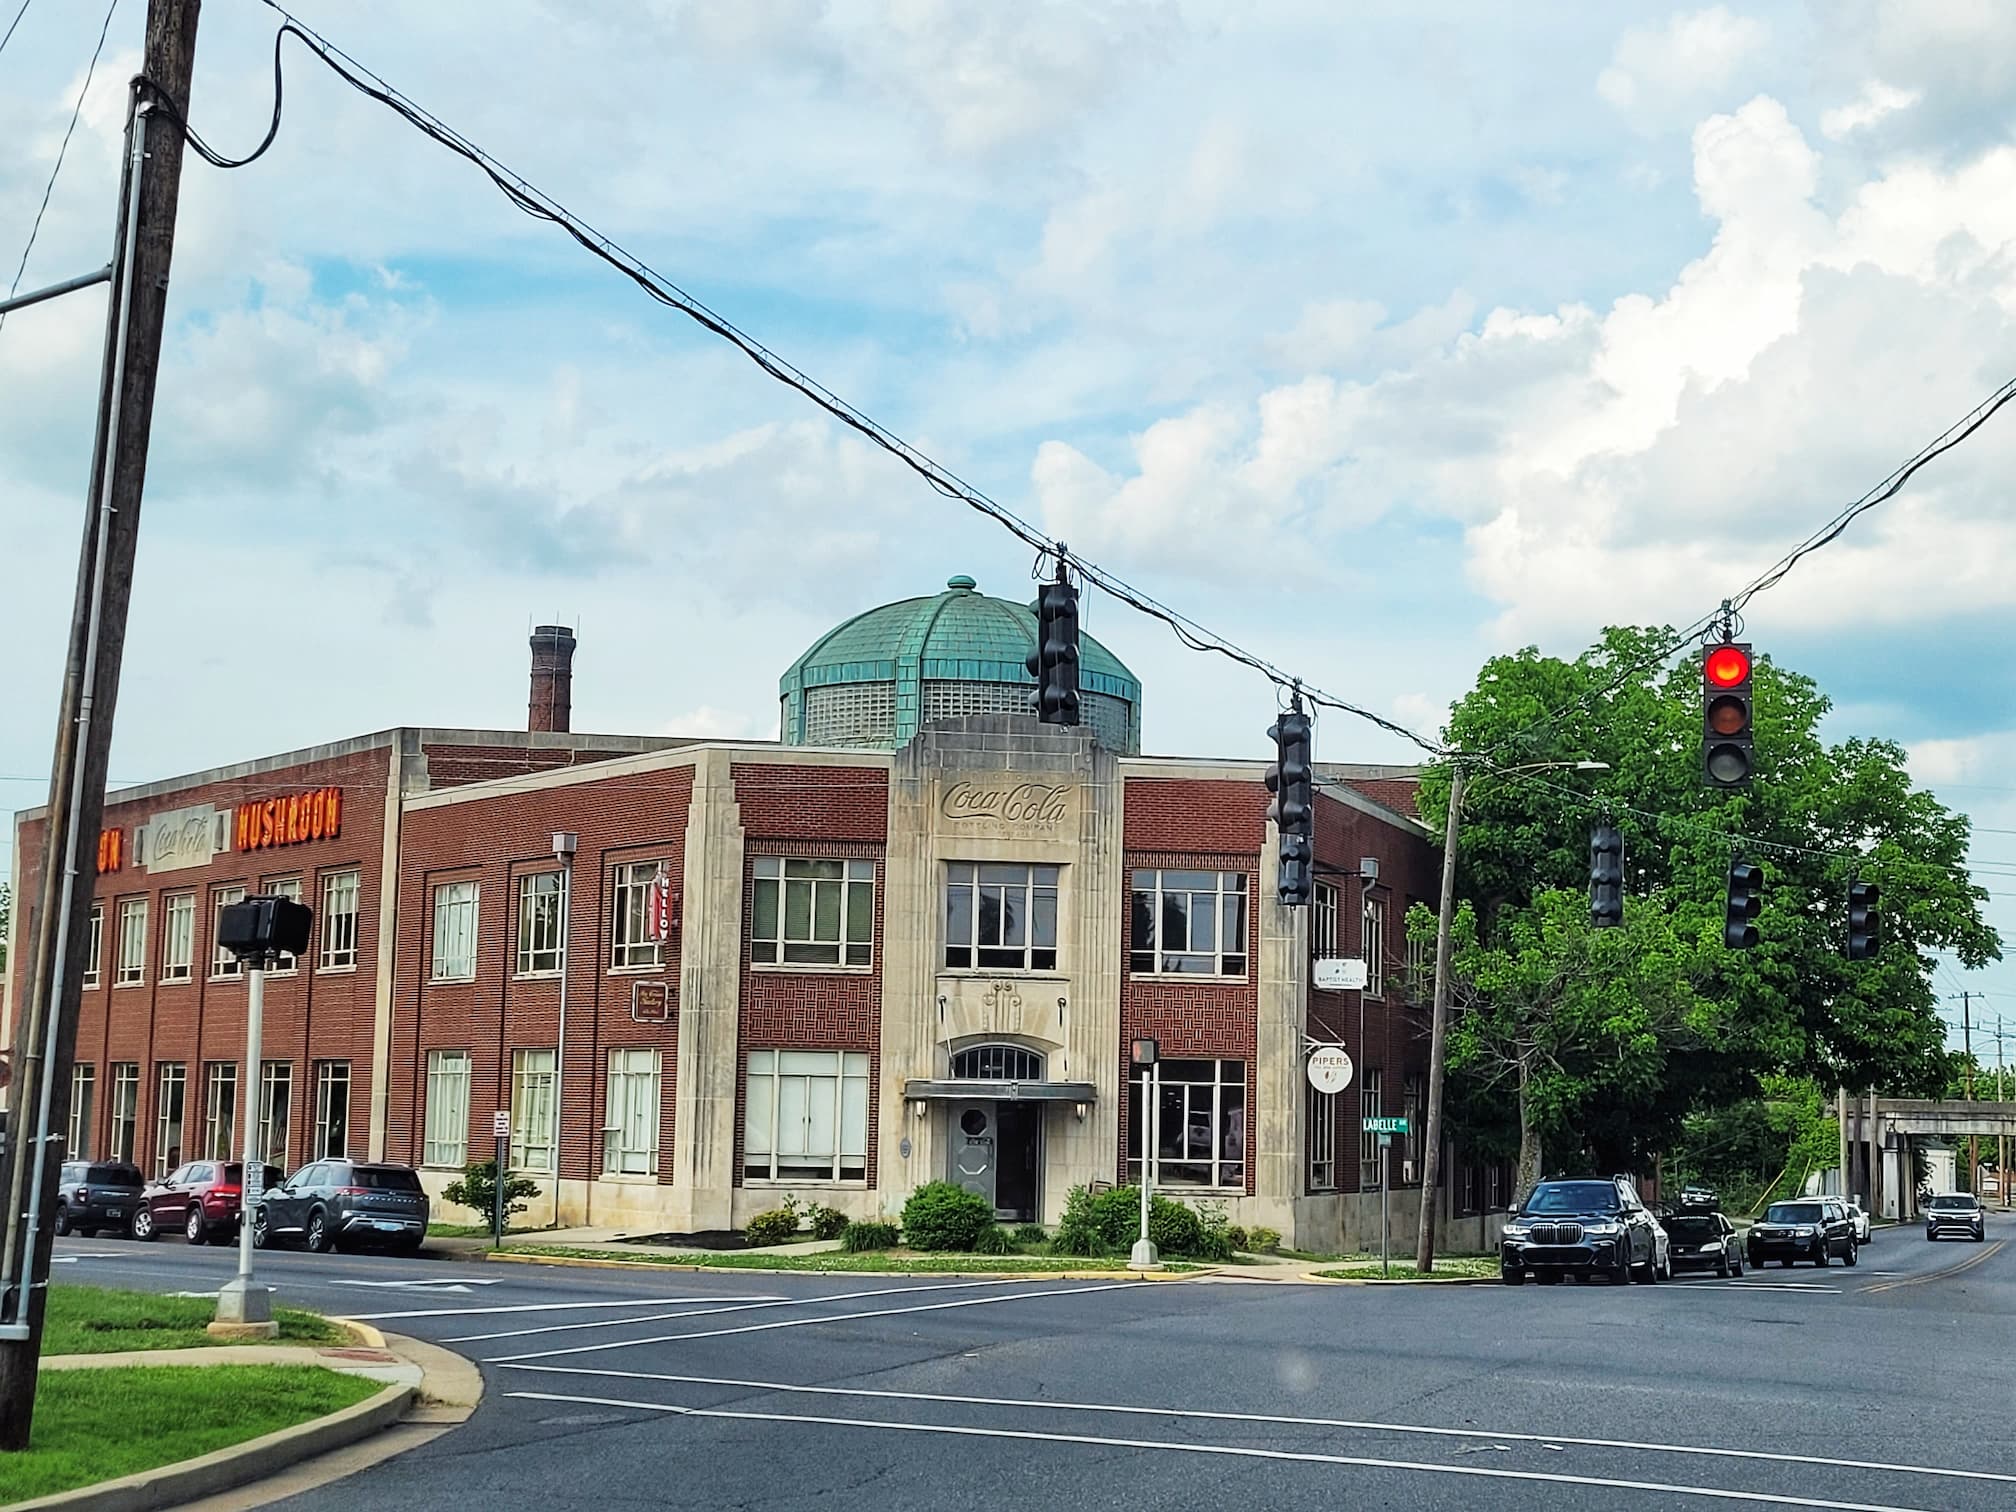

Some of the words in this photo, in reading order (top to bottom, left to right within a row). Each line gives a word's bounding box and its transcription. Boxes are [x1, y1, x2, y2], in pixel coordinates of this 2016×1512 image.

[236, 788, 342, 850] MUSHROOM
[1312, 1056, 1349, 1066] PIPERS
[1363, 1118, 1397, 1131] LABELLE
